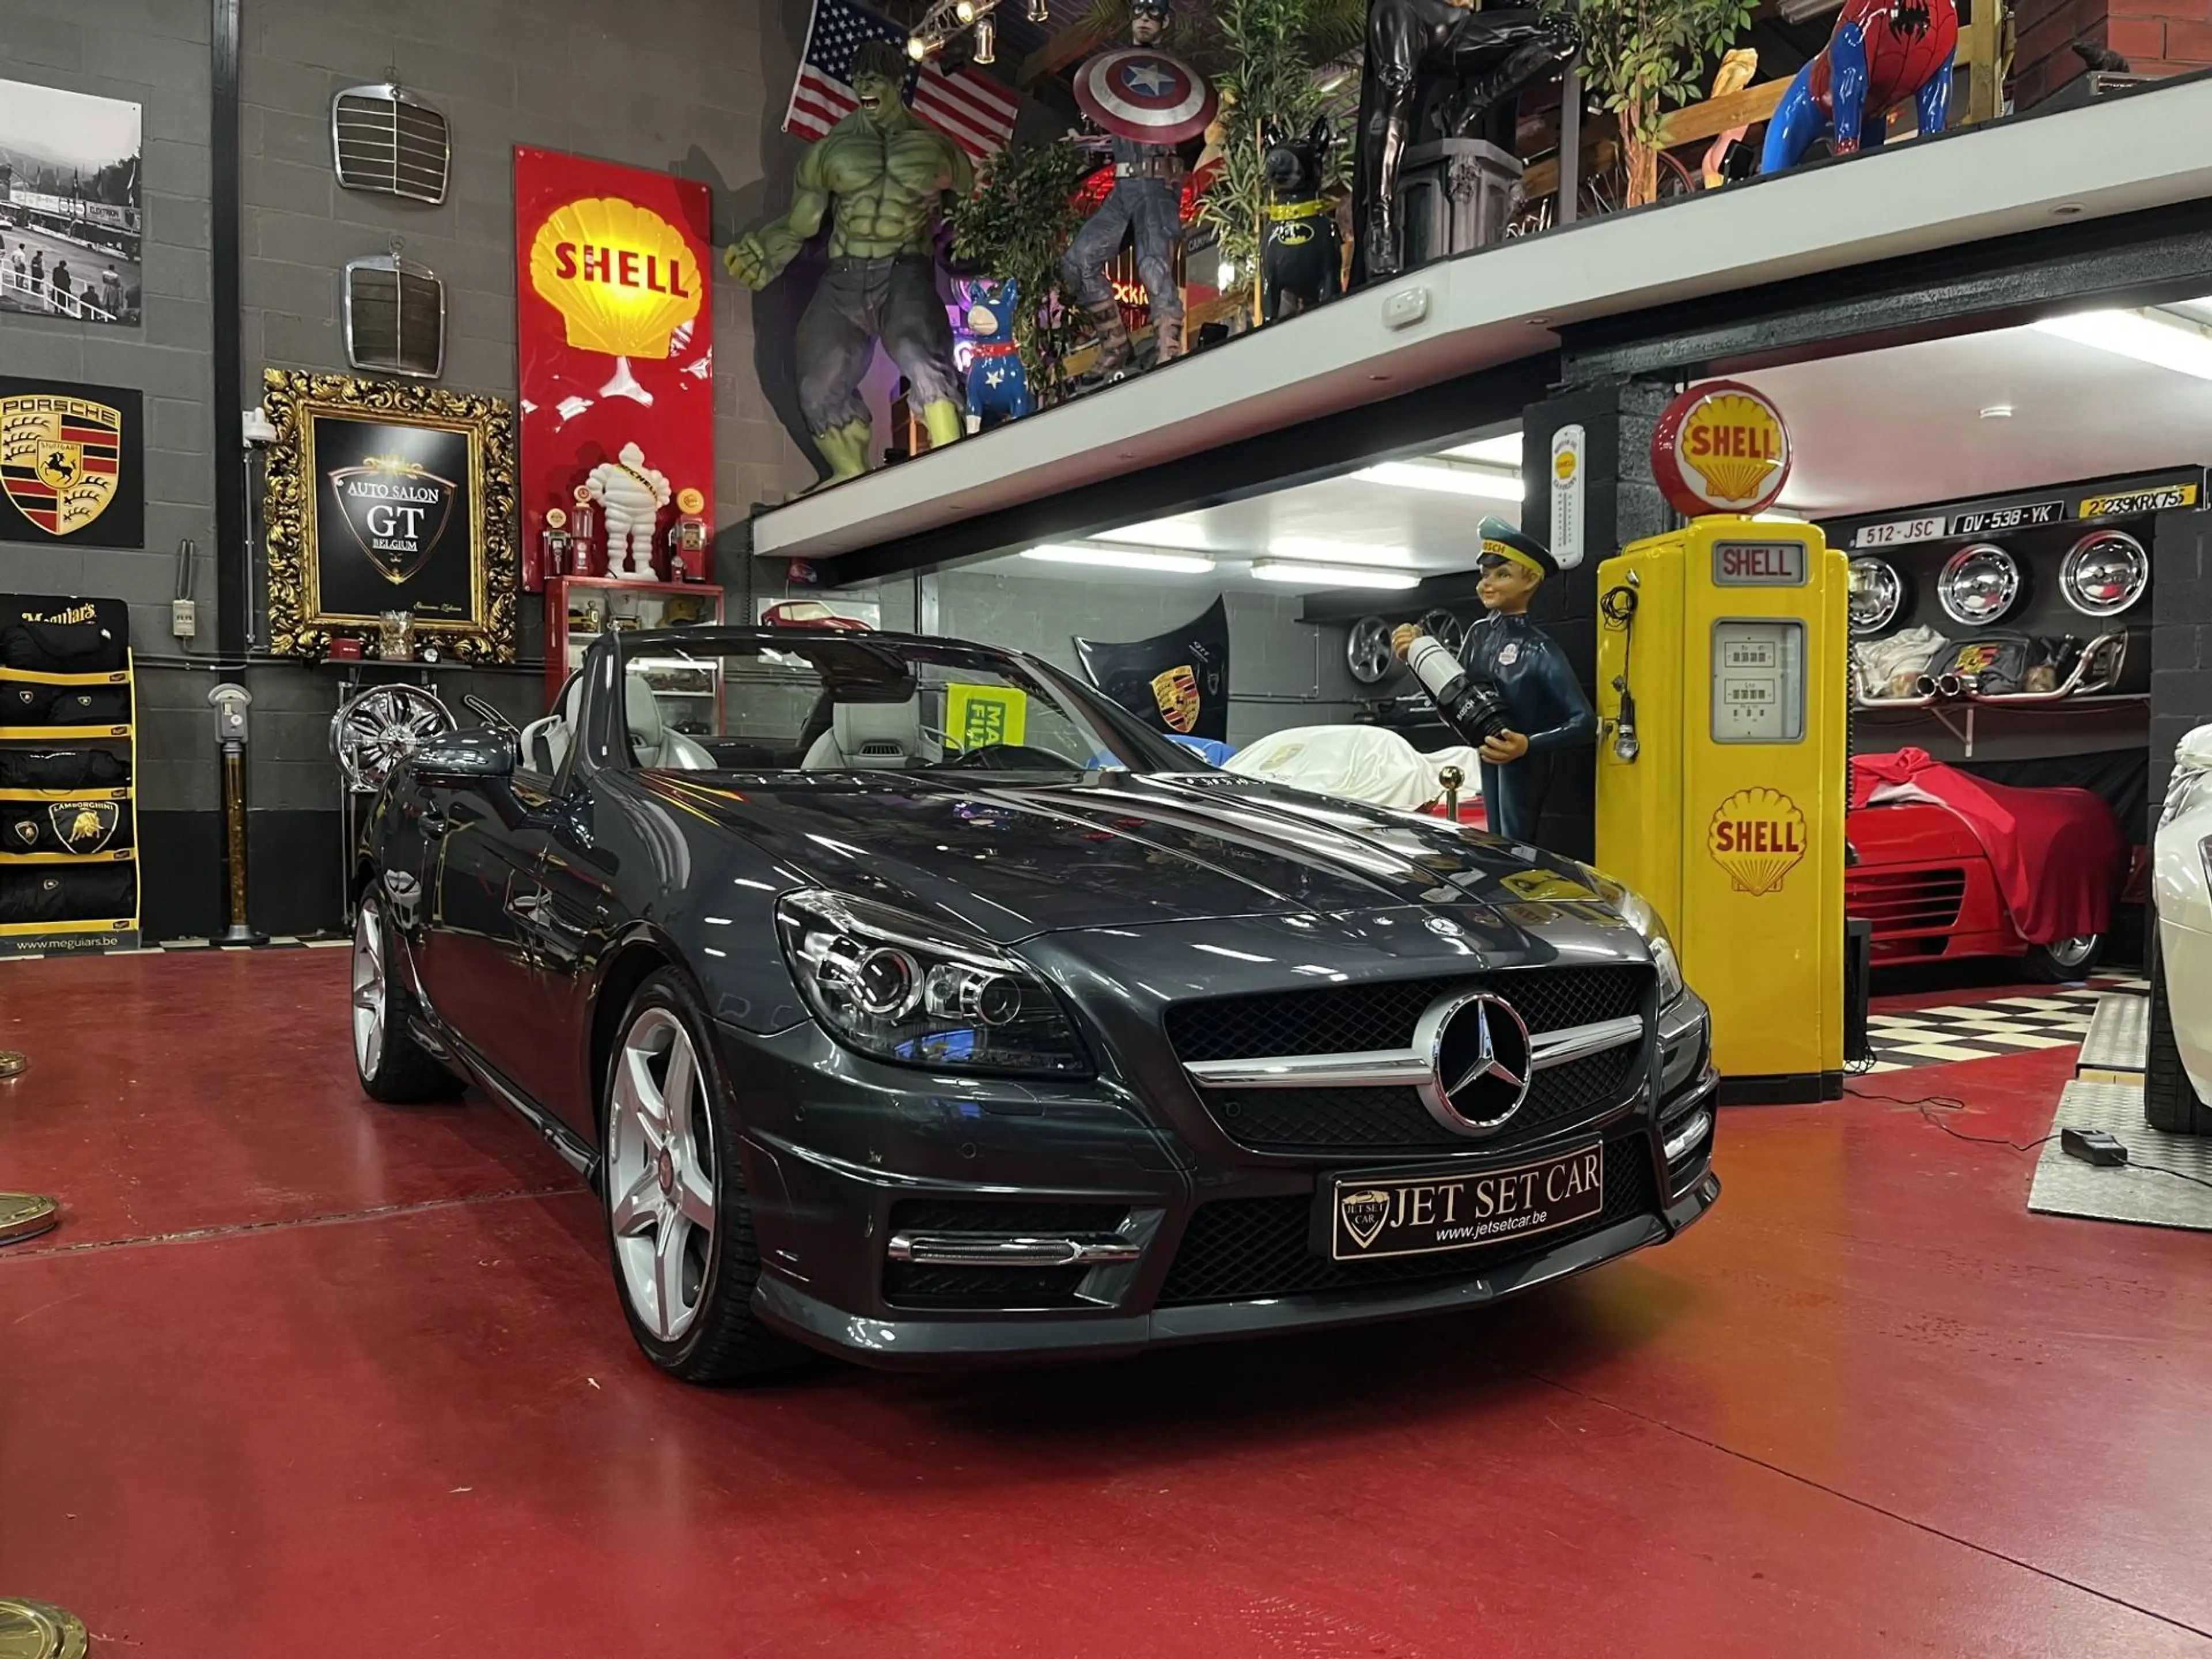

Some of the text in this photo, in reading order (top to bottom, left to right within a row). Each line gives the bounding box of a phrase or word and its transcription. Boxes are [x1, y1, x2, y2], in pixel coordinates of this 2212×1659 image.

[555, 242, 689, 299] SHELL
[3, 399, 116, 426] PORSCHE
[1692, 425, 1776, 460] SHELL
[348, 482, 439, 502] AUTO SALON
[367, 505, 425, 539] GT
[373, 538, 418, 550] BELGIUM
[1723, 549, 1792, 576] SHELL
[54, 802, 113, 812] LAMBORGHINI
[1715, 821, 1799, 853] SHELL
[17, 937, 118, 950] www.meguiars.be
[1389, 1154, 1600, 1228] JET SET CAR
[1347, 1204, 1383, 1214] JET SET
[1355, 1214, 1375, 1224] CAR
[1436, 1211, 1547, 1241] www.jetsetcar.be
